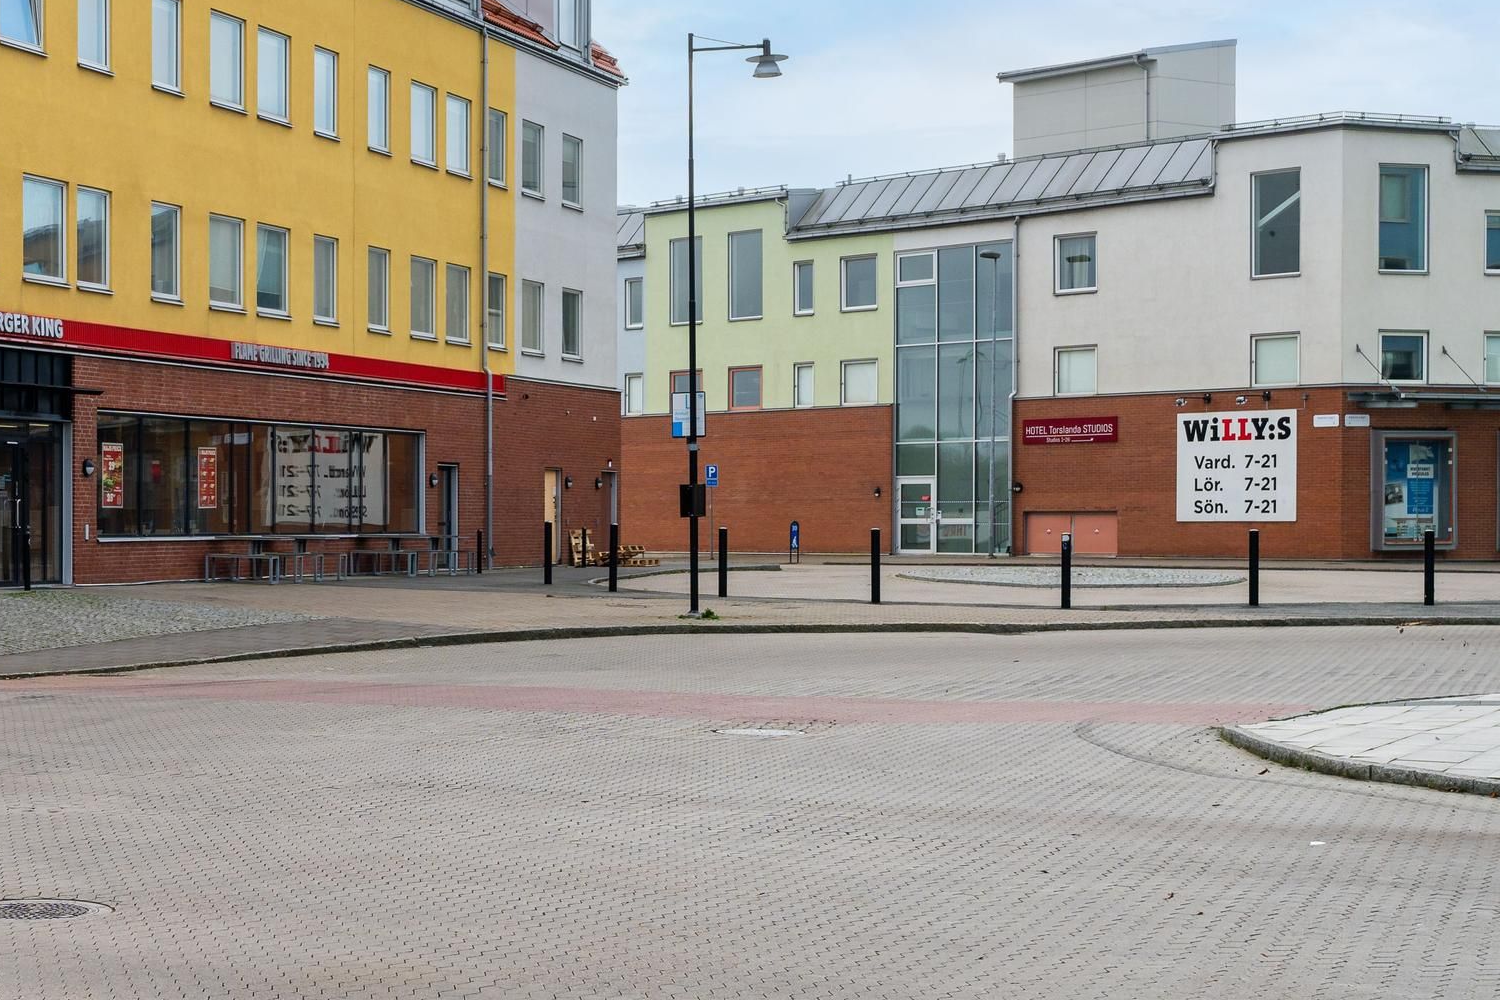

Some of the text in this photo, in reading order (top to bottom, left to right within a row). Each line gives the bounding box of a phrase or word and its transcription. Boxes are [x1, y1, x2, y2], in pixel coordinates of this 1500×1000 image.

[31, 316, 64, 339] KING
[233, 341, 259, 362] FLAME
[260, 346, 293, 366] GRILLING
[293, 349, 312, 367] SINCE
[1025, 423, 1114, 435] HOTEL Torslanda STUDIOS
[1194, 454, 1277, 470] Vard. 7-21
[708, 466, 716, 478] P
[1194, 477, 1277, 492] Lör. 7-21
[1194, 500, 1277, 514] Sön. 7-21
